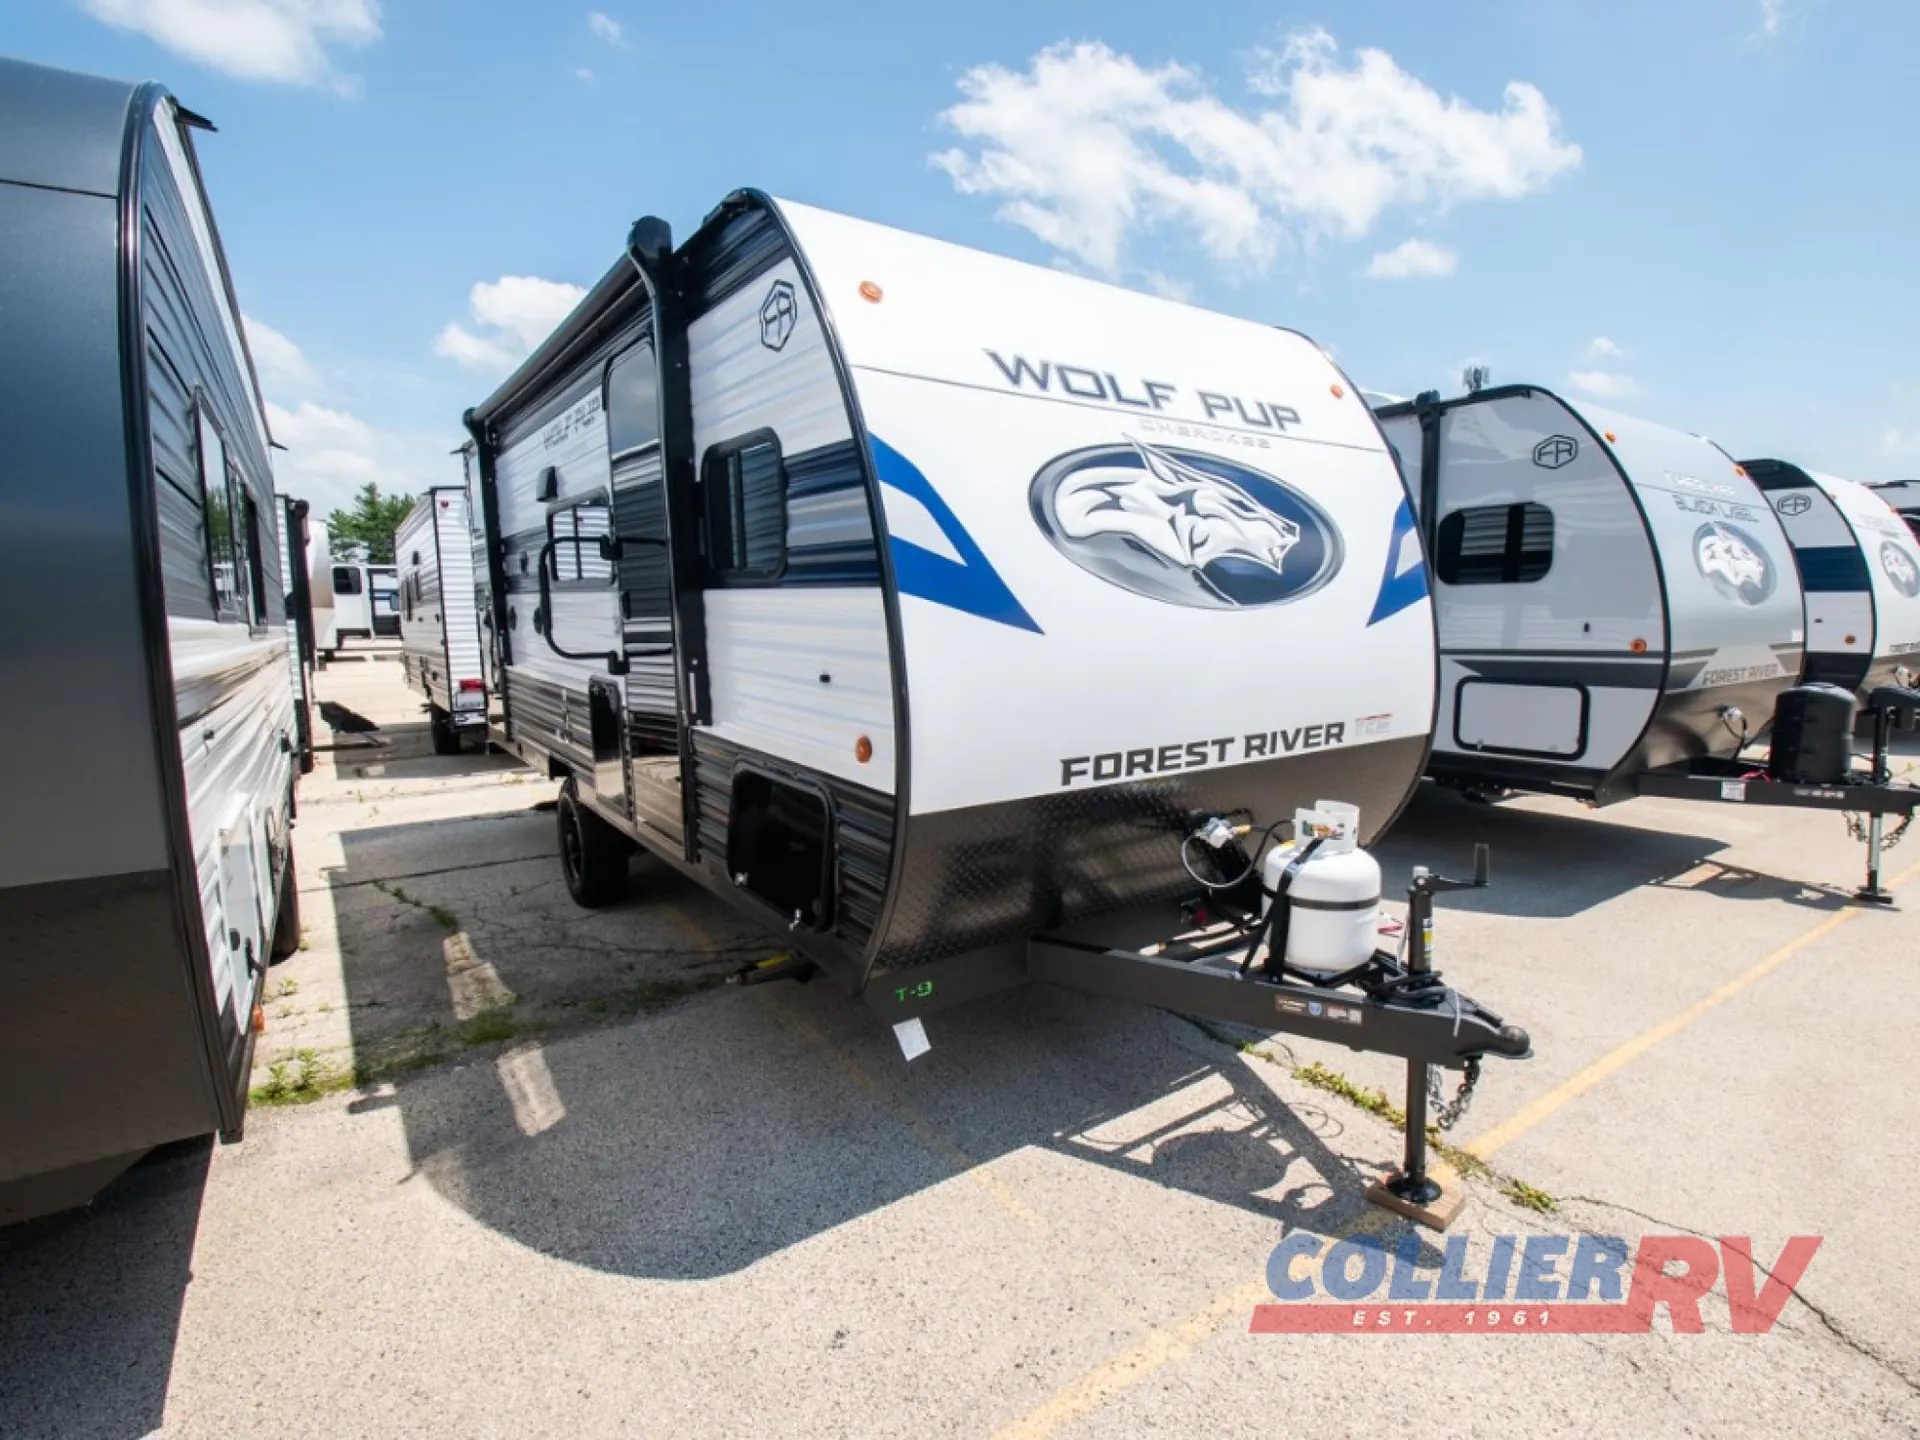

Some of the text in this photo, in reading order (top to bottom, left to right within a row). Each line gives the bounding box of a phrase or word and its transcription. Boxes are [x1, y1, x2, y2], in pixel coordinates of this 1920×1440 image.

[985, 350, 1302, 432] WOLF PUP
[1702, 666, 1747, 685] FOREST
[1060, 736, 1236, 787] FOREST
[1243, 720, 1346, 759] RIVER
